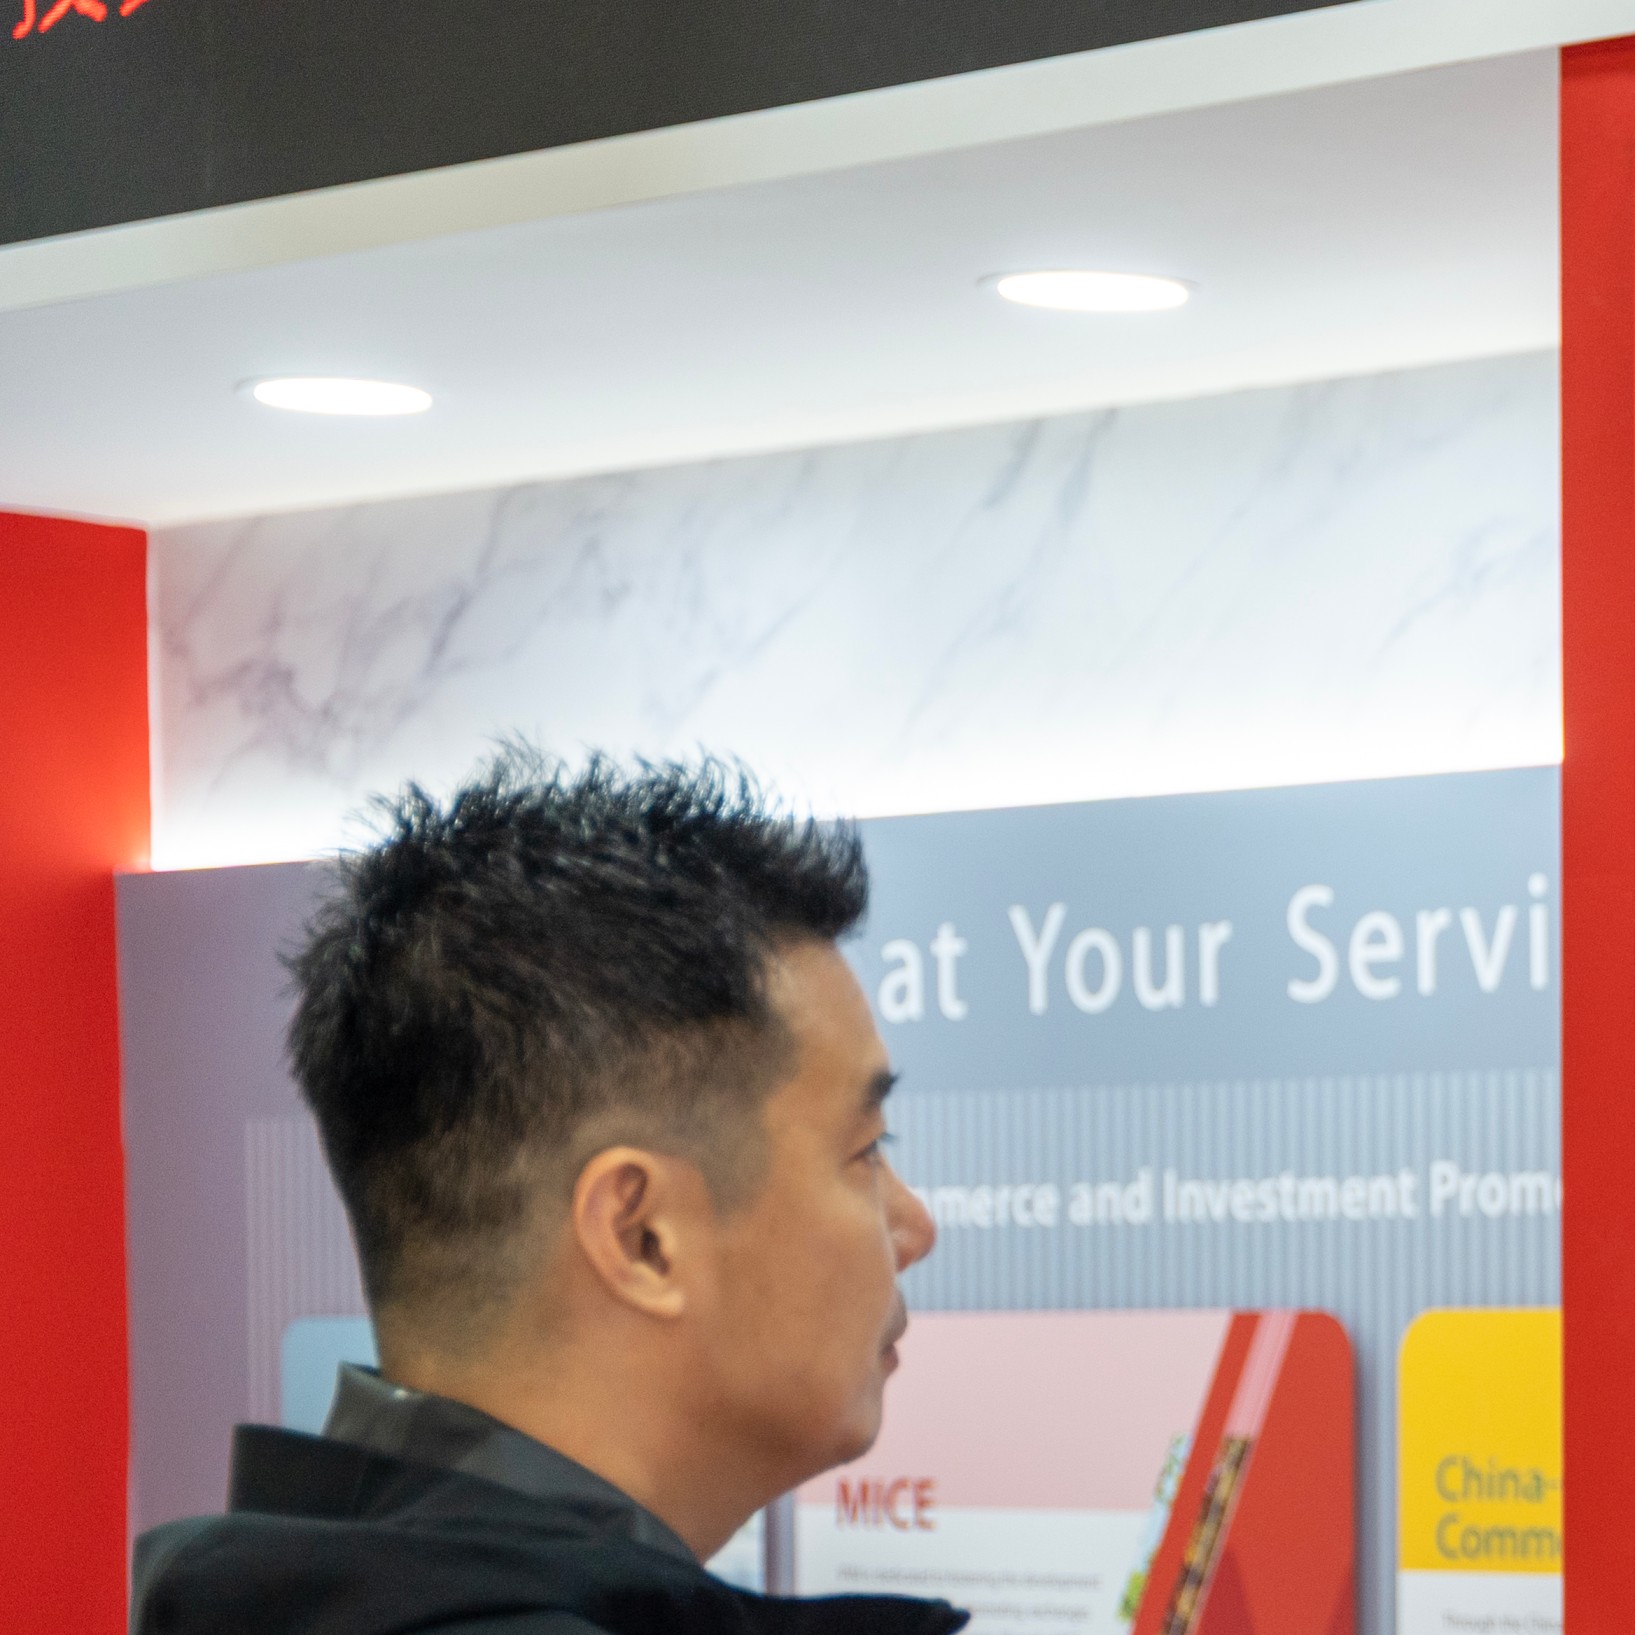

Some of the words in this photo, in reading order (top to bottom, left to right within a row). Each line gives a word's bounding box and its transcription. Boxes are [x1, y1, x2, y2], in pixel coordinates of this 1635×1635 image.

[877, 923, 967, 1024] at
[1009, 904, 1232, 1013] Your
[1287, 872, 1549, 1003] Servi
[1069, 1168, 1153, 1225] and
[1164, 1167, 1420, 1222] Investment
[1430, 1158, 1562, 1219] Prom
[836, 1476, 936, 1529] MICE
[1435, 1511, 1561, 1561] Comm
